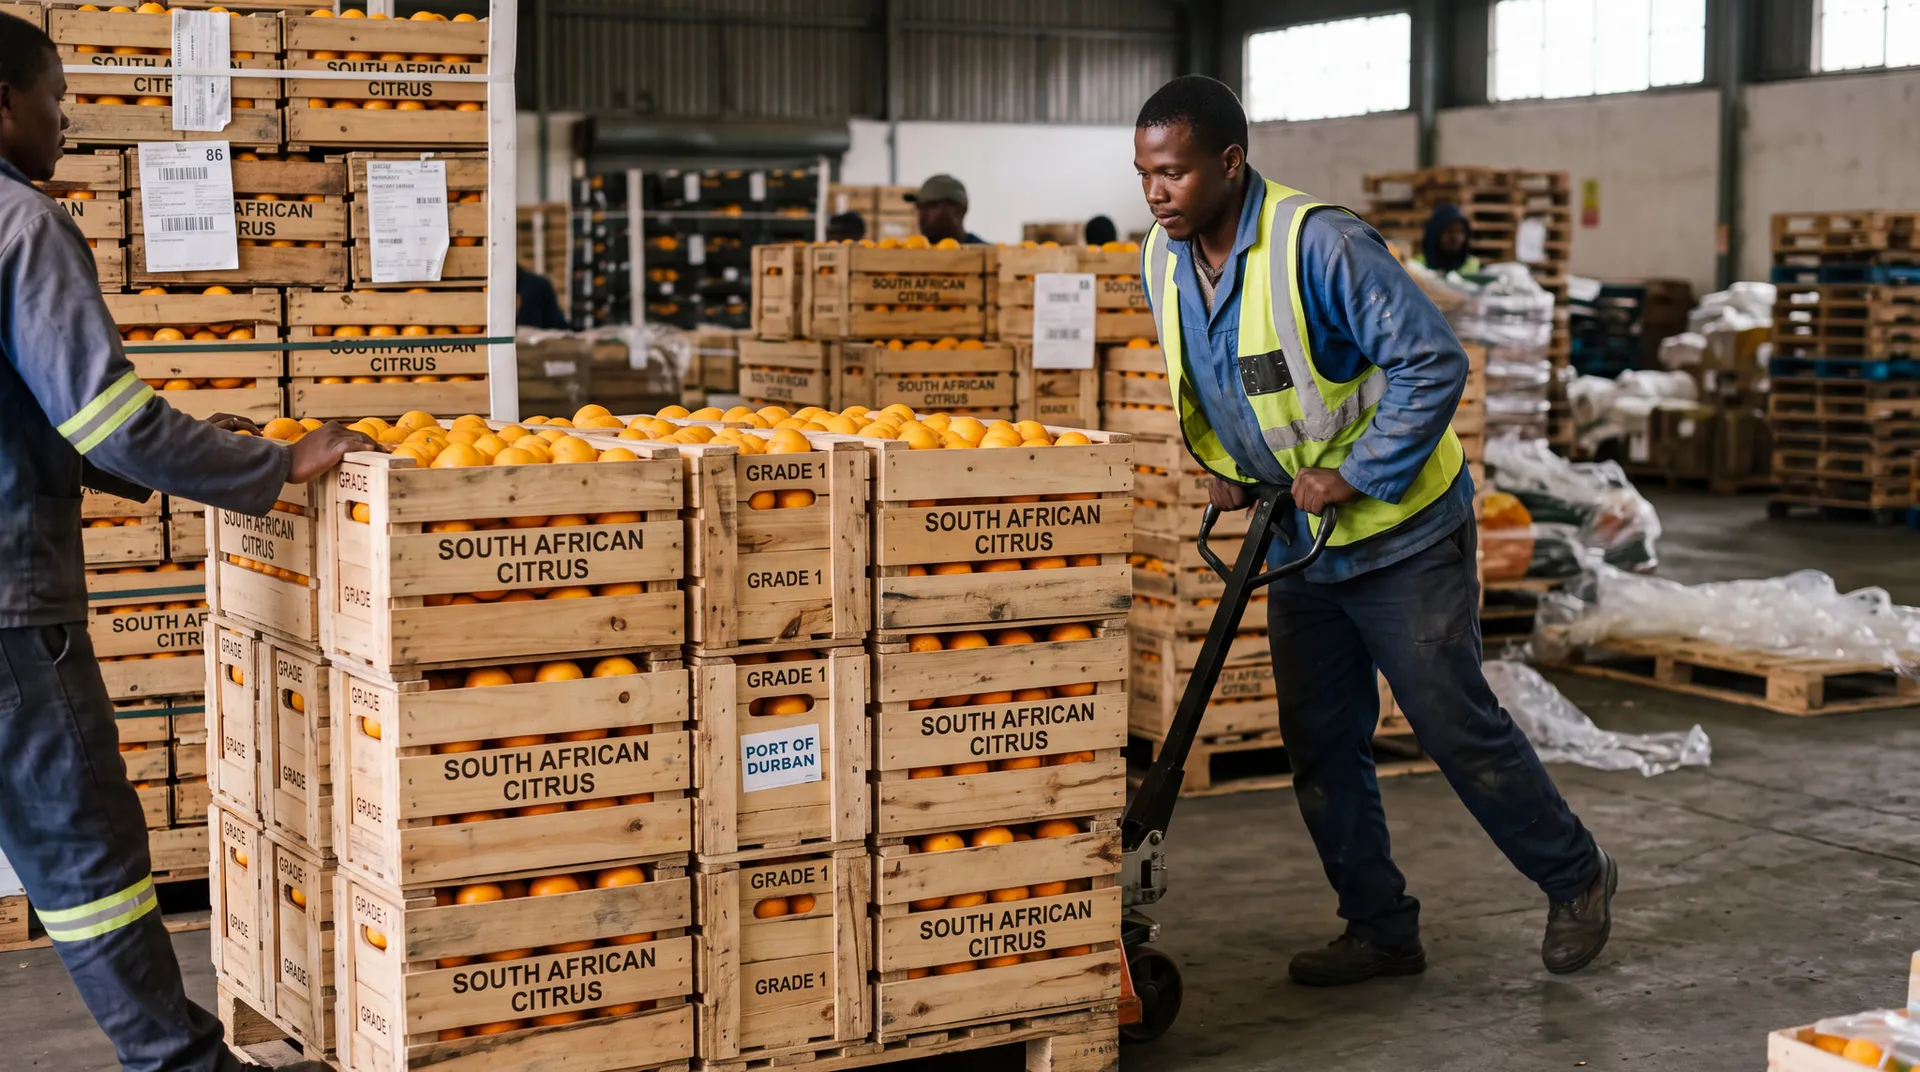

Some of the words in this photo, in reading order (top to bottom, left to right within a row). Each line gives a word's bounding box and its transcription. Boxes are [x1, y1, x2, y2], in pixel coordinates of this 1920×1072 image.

[327, 62, 388, 72] SOUTH
[134, 77, 172, 92] CITR
[368, 81, 433, 97] CITRUS
[206, 148, 223, 162] 86
[234, 202, 312, 218] AFRICAN
[236, 220, 276, 236] RUS
[873, 277, 912, 289] SOUTH
[915, 279, 965, 290] AFRICAN
[370, 357, 436, 372] CITRUS
[897, 381, 939, 392] SOUTH
[942, 380, 995, 391] AFRICAN
[924, 394, 968, 406] CITRUS
[339, 471, 368, 493] GRADE
[746, 464, 812, 482] GRADE
[818, 462, 826, 479] 1
[254, 516, 294, 540] AFRICAN
[925, 510, 1000, 532] SOUTH
[1006, 504, 1100, 529] AFRICAN
[242, 534, 274, 560] CITRUS
[438, 535, 526, 560] SOUTH
[534, 529, 644, 556] AFRICAN
[975, 532, 1053, 556] CITRUS
[496, 558, 590, 584] CITRUS
[747, 571, 809, 589] GRADE
[816, 569, 822, 586] 1
[344, 586, 371, 608] GRADE
[112, 614, 178, 633] SOUTH
[157, 630, 204, 648] CITR
[222, 637, 242, 660] GRADE
[278, 660, 302, 684] GRADE
[746, 668, 813, 689] GRADE
[820, 666, 826, 683] 1
[352, 686, 380, 712] GRADE
[921, 710, 995, 736] SOUTH
[1002, 702, 1095, 730] AFRICAN
[226, 736, 246, 760] GRADE
[746, 740, 788, 759] PORT
[792, 737, 814, 752] OF
[970, 730, 1048, 757] CITRUS
[444, 752, 532, 780] SOUTH
[539, 740, 650, 771] AFRICAN
[748, 754, 814, 775] DURBAN
[283, 766, 306, 790] GRADE
[503, 773, 595, 802] CITRUS
[356, 797, 382, 824] GRADE
[225, 821, 246, 846] GRADE
[279, 856, 302, 884] GRADE
[750, 868, 816, 890] GRADE
[821, 866, 828, 884] 1
[356, 896, 382, 924] GRADE
[920, 916, 996, 940] SOUTH
[1000, 900, 1092, 930] AFRICAN
[230, 913, 249, 939] GRADE
[968, 930, 1046, 958] CITRUS
[284, 958, 306, 986] GRADE
[452, 964, 544, 995] SOUTH
[548, 948, 657, 979] AFRICAN
[755, 976, 813, 996] GRADE
[819, 973, 826, 990] 1
[511, 981, 604, 1013] CITRUS
[361, 1006, 386, 1035] GRADE
